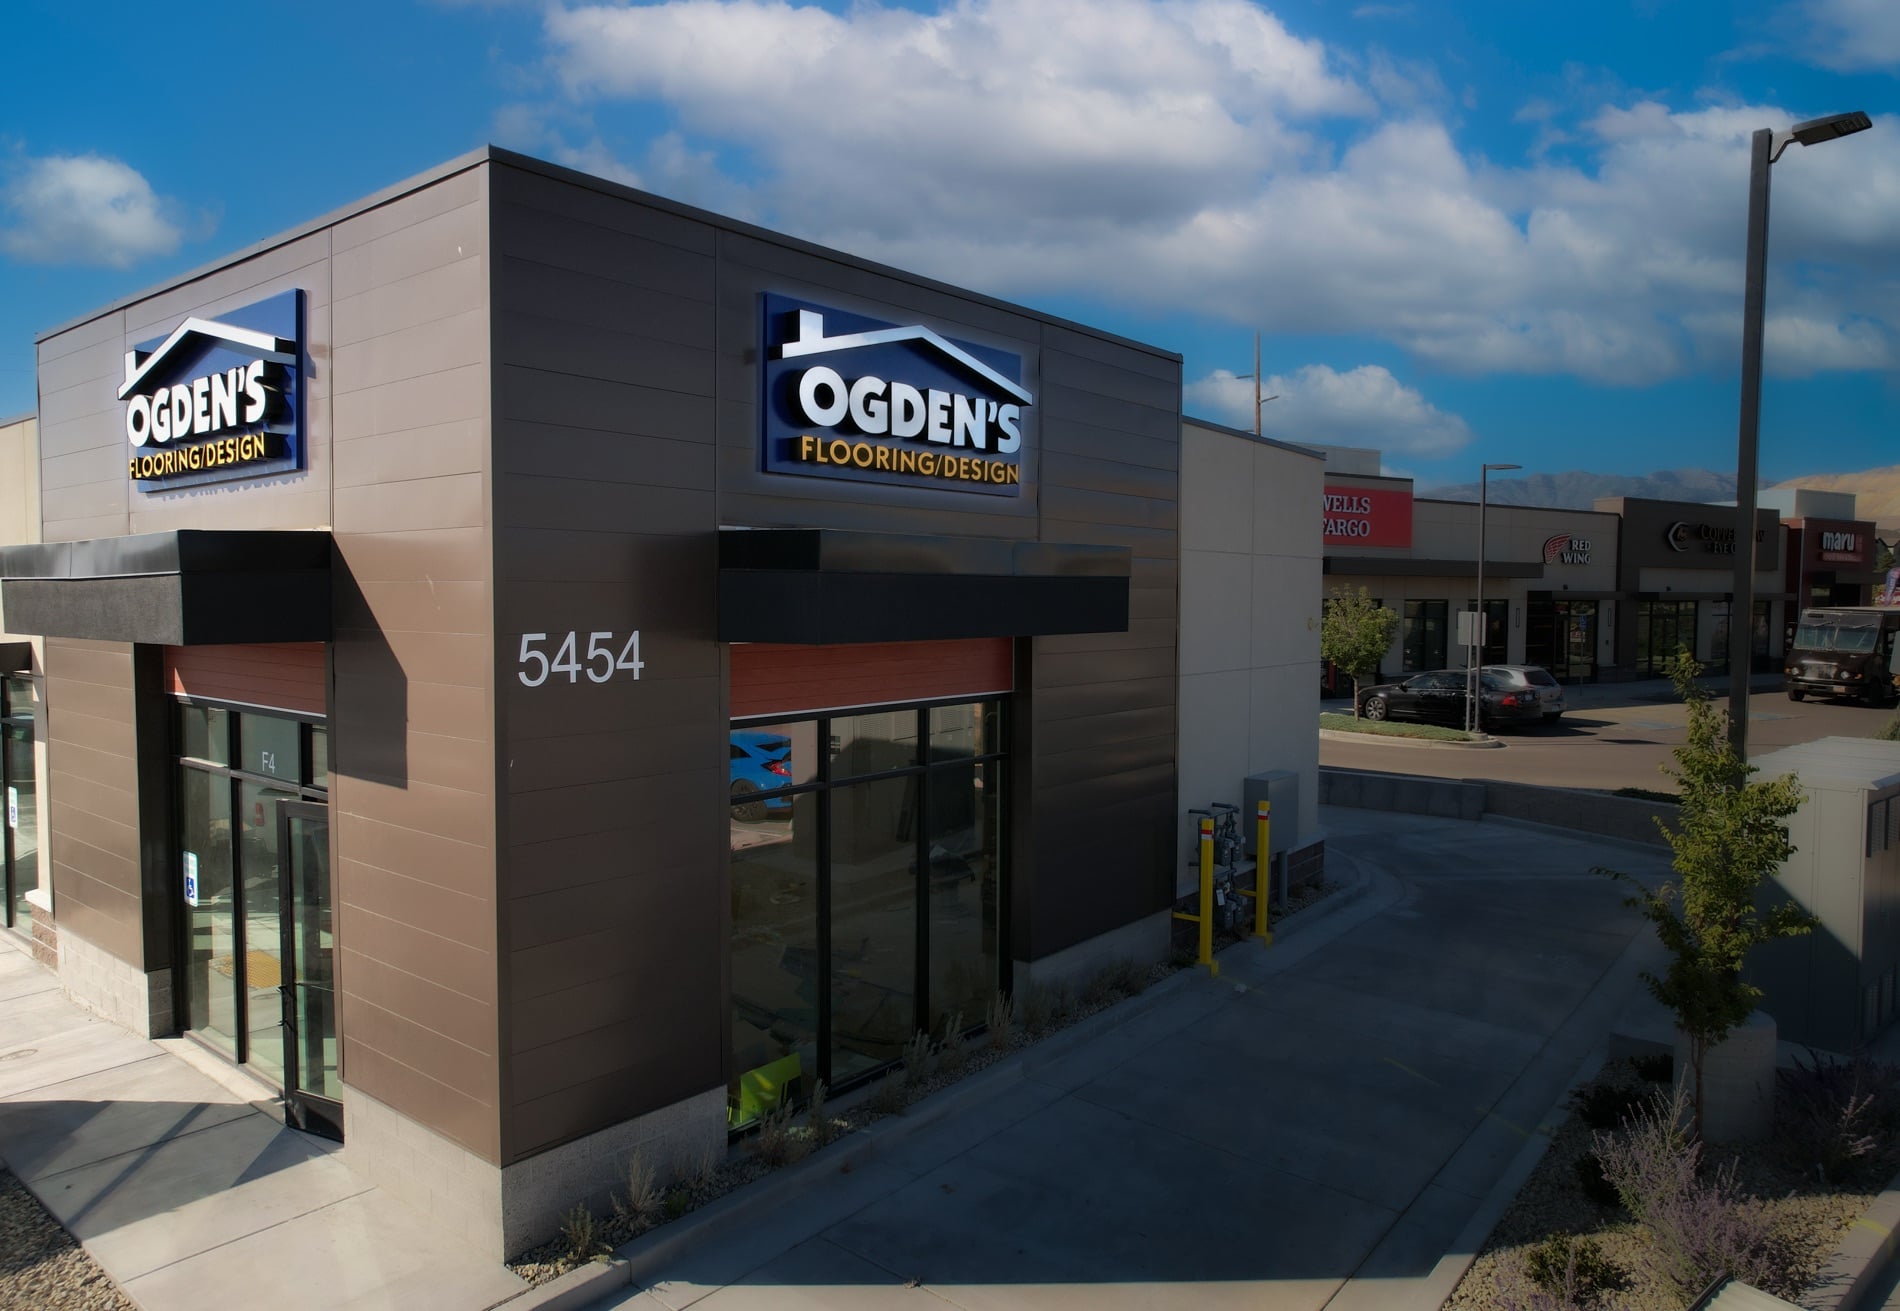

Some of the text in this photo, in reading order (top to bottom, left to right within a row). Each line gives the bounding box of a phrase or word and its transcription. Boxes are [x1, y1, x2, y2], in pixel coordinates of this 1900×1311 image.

[126, 359, 266, 448] OGDEN'S
[799, 366, 1021, 454] OGDEN'S
[129, 431, 265, 480] FLOORING/DESIGN
[801, 435, 1019, 484] FLOORING/DESIGN
[1562, 552, 1591, 564] WING
[1572, 540, 1591, 551] RED
[1714, 542, 1729, 554] EYE
[1822, 531, 1855, 551] maru
[518, 630, 645, 687] 5454
[261, 751, 276, 774] F4
